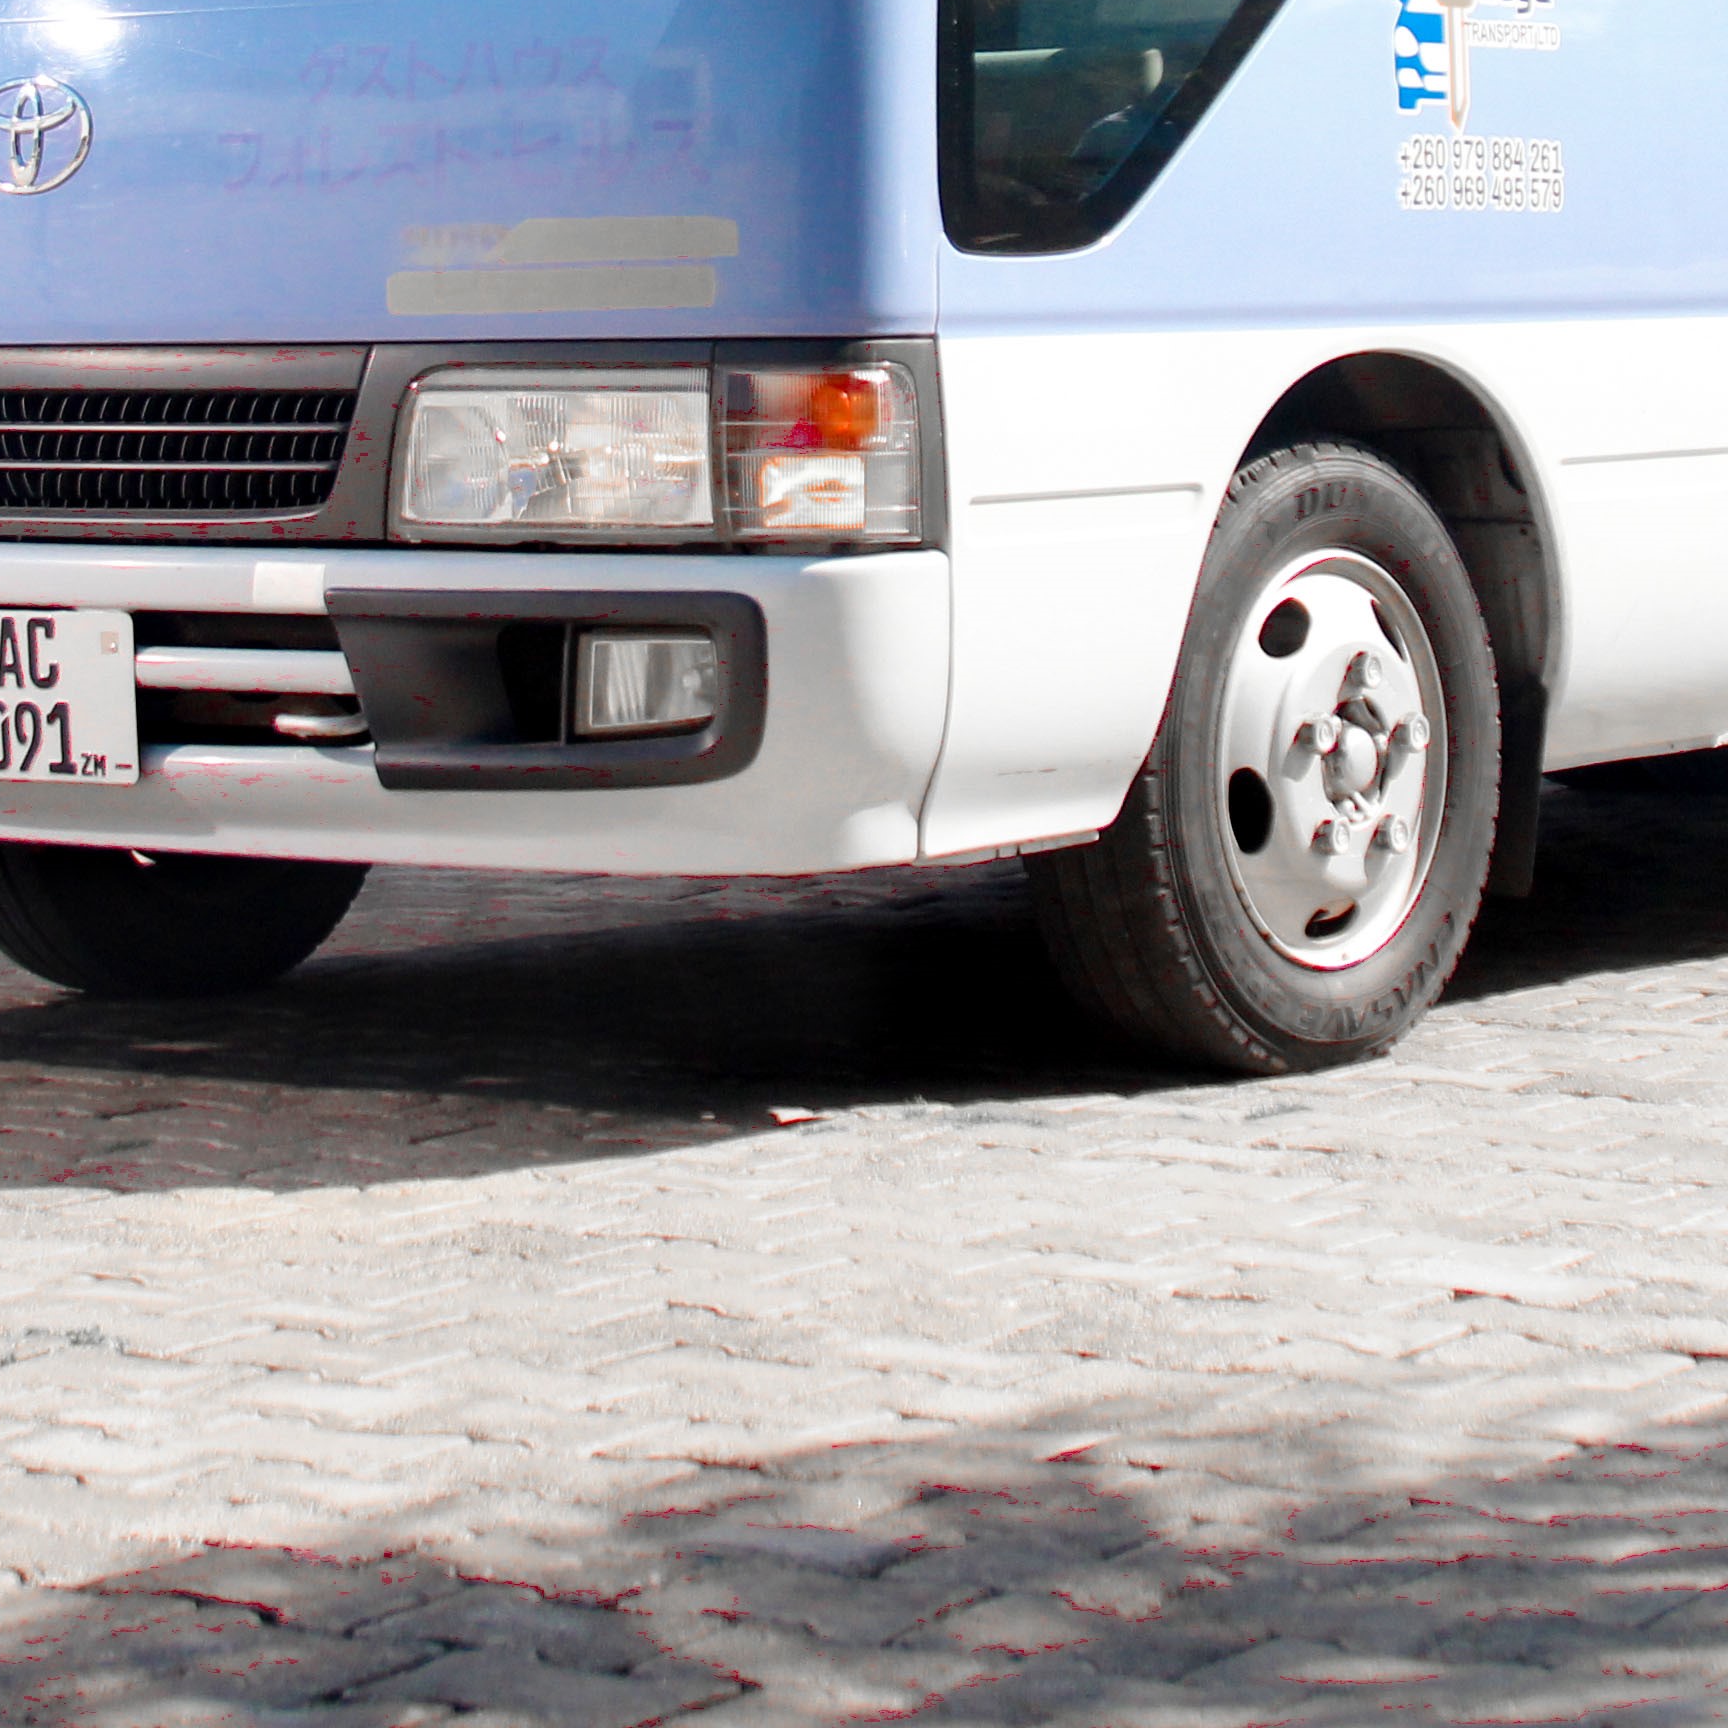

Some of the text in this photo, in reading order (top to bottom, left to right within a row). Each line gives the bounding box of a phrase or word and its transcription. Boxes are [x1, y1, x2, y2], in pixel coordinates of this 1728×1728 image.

[1464, 22, 1535, 46] TRANSPORT
[1400, 138, 1563, 174] +260 979 884 261
[1400, 174, 1563, 209] +260 969 495 579
[80, 752, 107, 776] ZM
